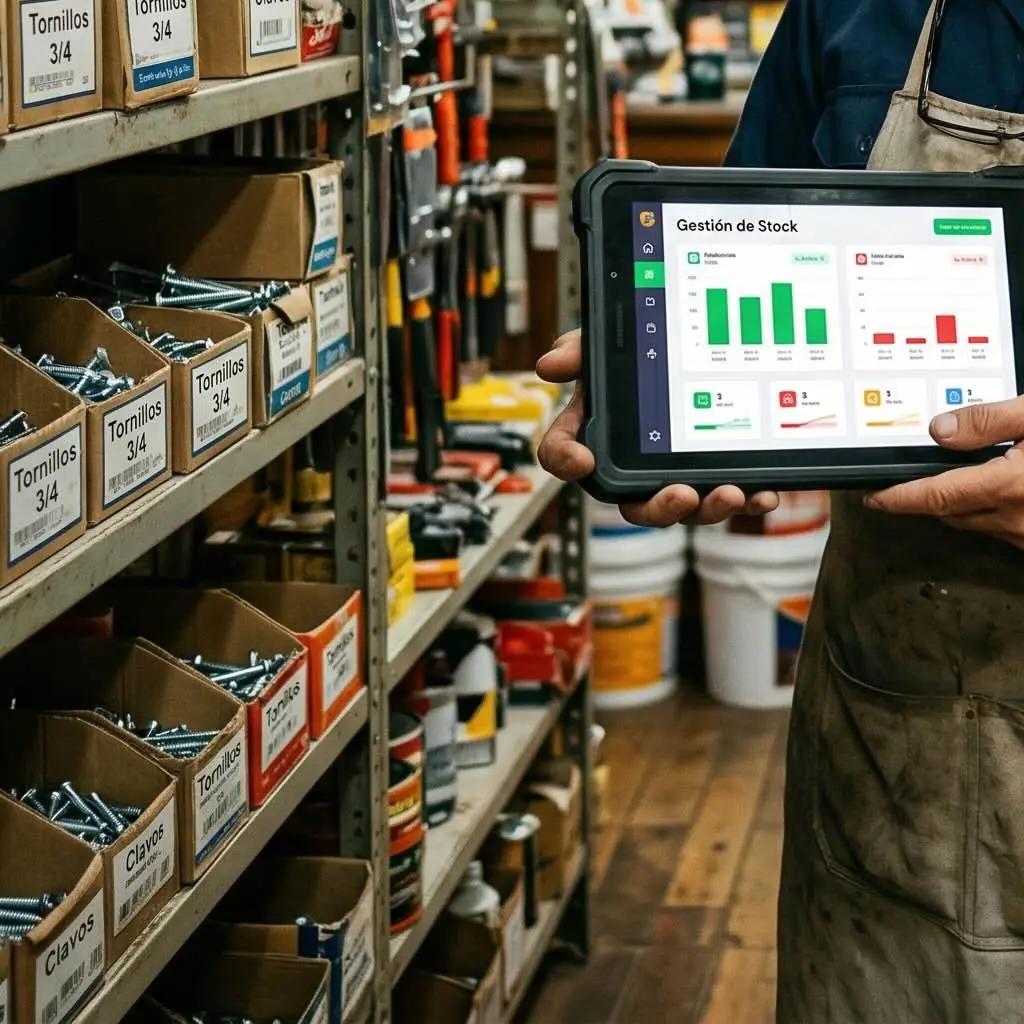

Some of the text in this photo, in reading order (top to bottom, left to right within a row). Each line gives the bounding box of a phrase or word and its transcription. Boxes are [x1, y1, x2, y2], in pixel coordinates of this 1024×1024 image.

[29, 11, 90, 35] Tornillos
[152, 19, 173, 42] 3/4
[50, 40, 72, 65] 3/4
[677, 219, 799, 233] Gestión de Stock
[196, 357, 245, 394] Tornillos
[212, 394, 231, 414] 3/4
[108, 399, 162, 443] Tornillos
[127, 439, 147, 463] 3/4
[14, 444, 77, 493] Tornillos
[35, 481, 59, 513] 3/4
[197, 741, 241, 796] Tornillos
[126, 823, 164, 872] Clavos
[44, 913, 95, 977] Clavos
